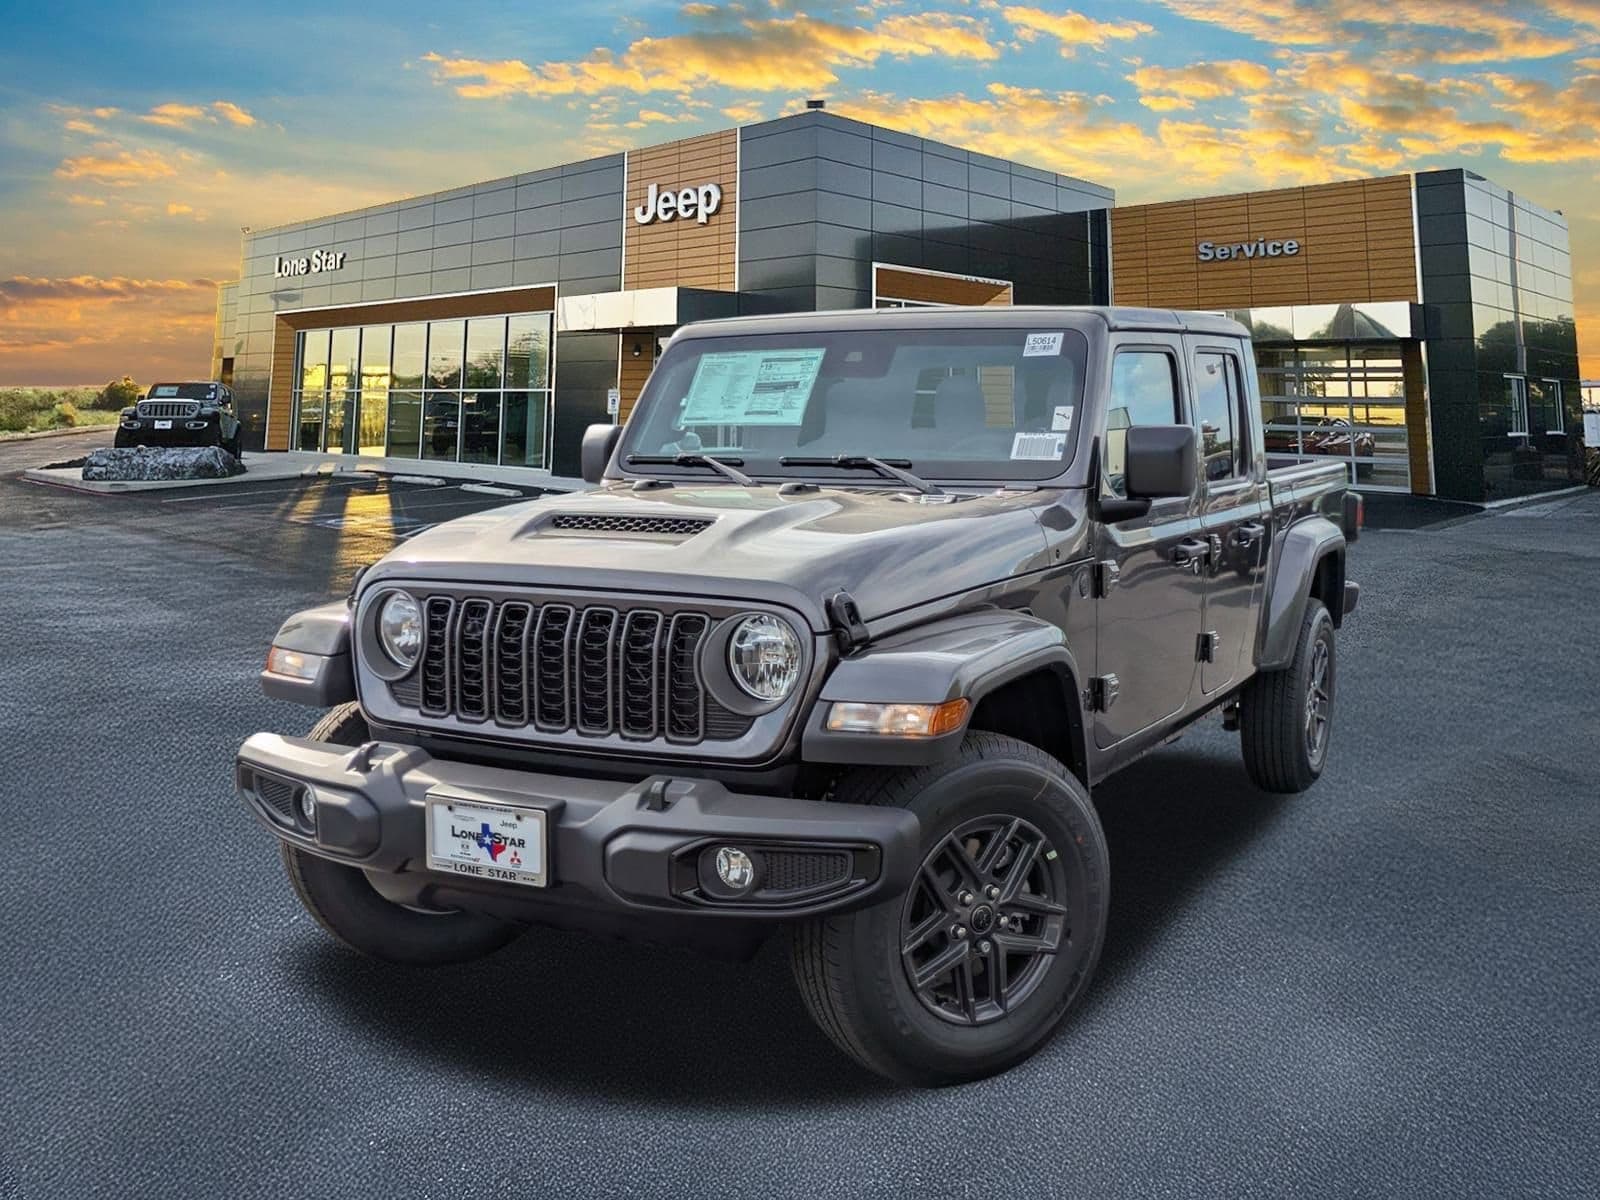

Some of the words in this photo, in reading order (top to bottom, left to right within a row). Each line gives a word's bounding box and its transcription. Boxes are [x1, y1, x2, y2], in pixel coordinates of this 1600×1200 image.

[634, 182, 721, 224] Jeep
[1198, 236, 1299, 261] Service
[274, 256, 309, 278] Lone
[311, 249, 346, 273] Star
[451, 825, 482, 842] LONE
[492, 832, 526, 849] STAR
[500, 820, 518, 830] Jeep
[454, 863, 483, 876] LONE
[488, 868, 517, 881] STAR
